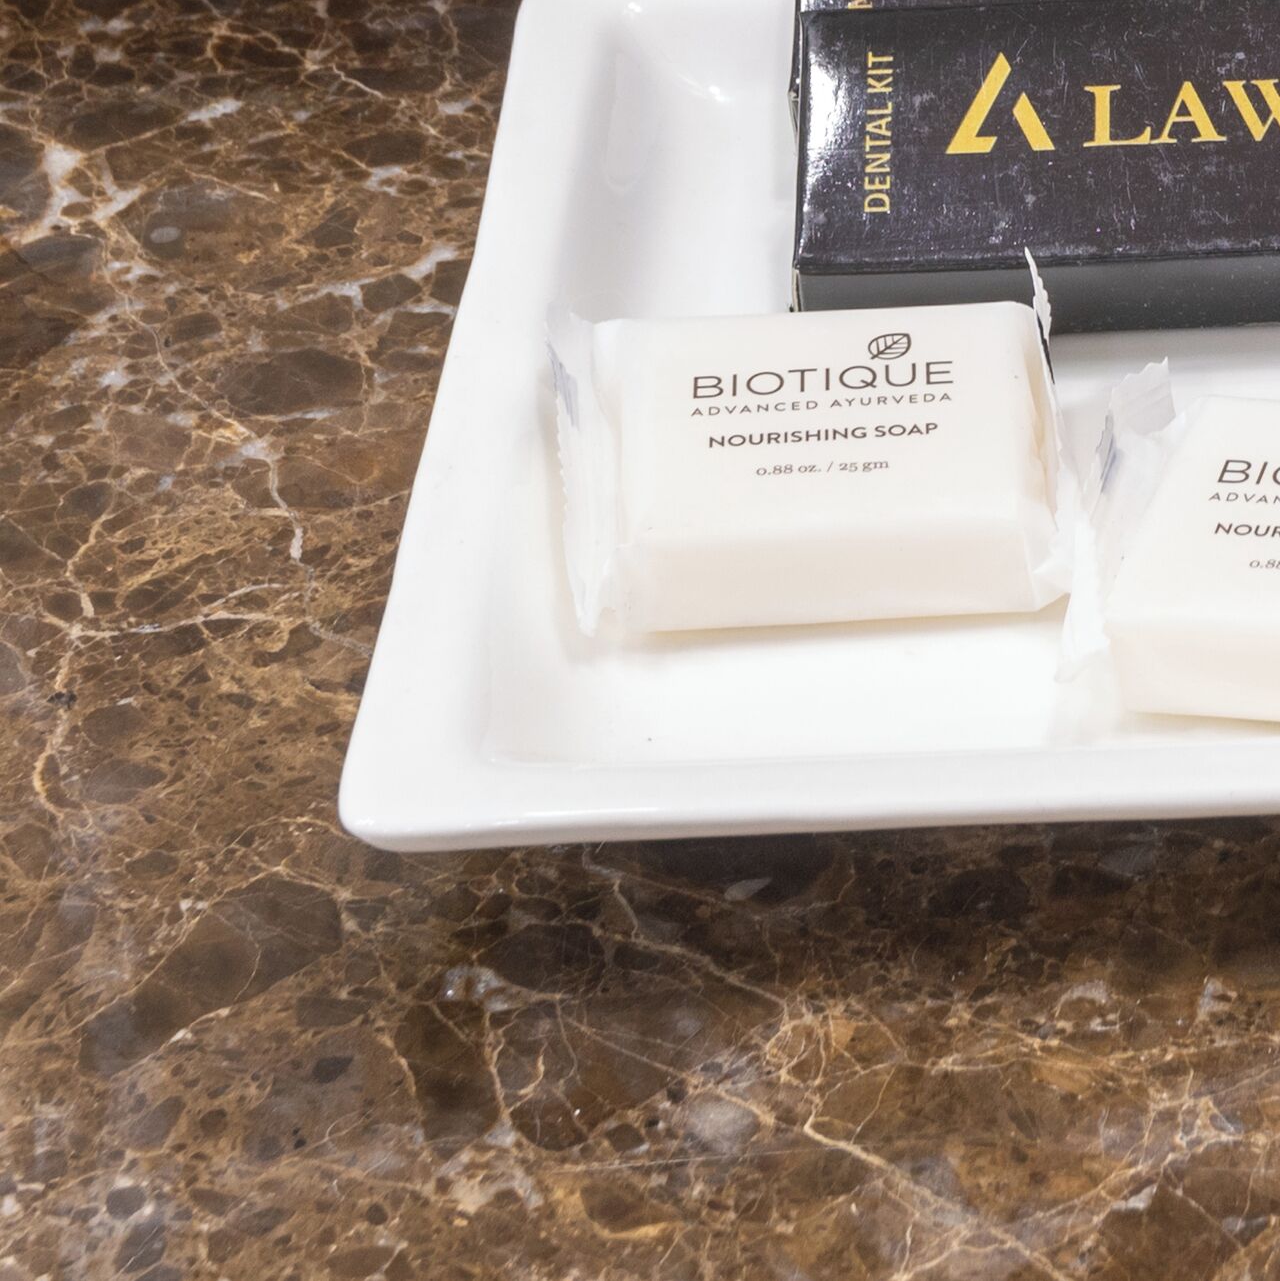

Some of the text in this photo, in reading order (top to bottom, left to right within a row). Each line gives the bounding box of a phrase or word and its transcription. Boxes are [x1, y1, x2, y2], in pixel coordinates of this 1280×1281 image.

[863, 51, 895, 213] DENTAL KIT
[692, 361, 954, 399] BIOTIQUE
[691, 392, 952, 417] ADVANCED AYURVEDA
[708, 422, 939, 448] NOURISHING SOAP
[756, 464, 793, 476] 0.88
[839, 462, 858, 473] 25
[862, 460, 890, 472] gm
